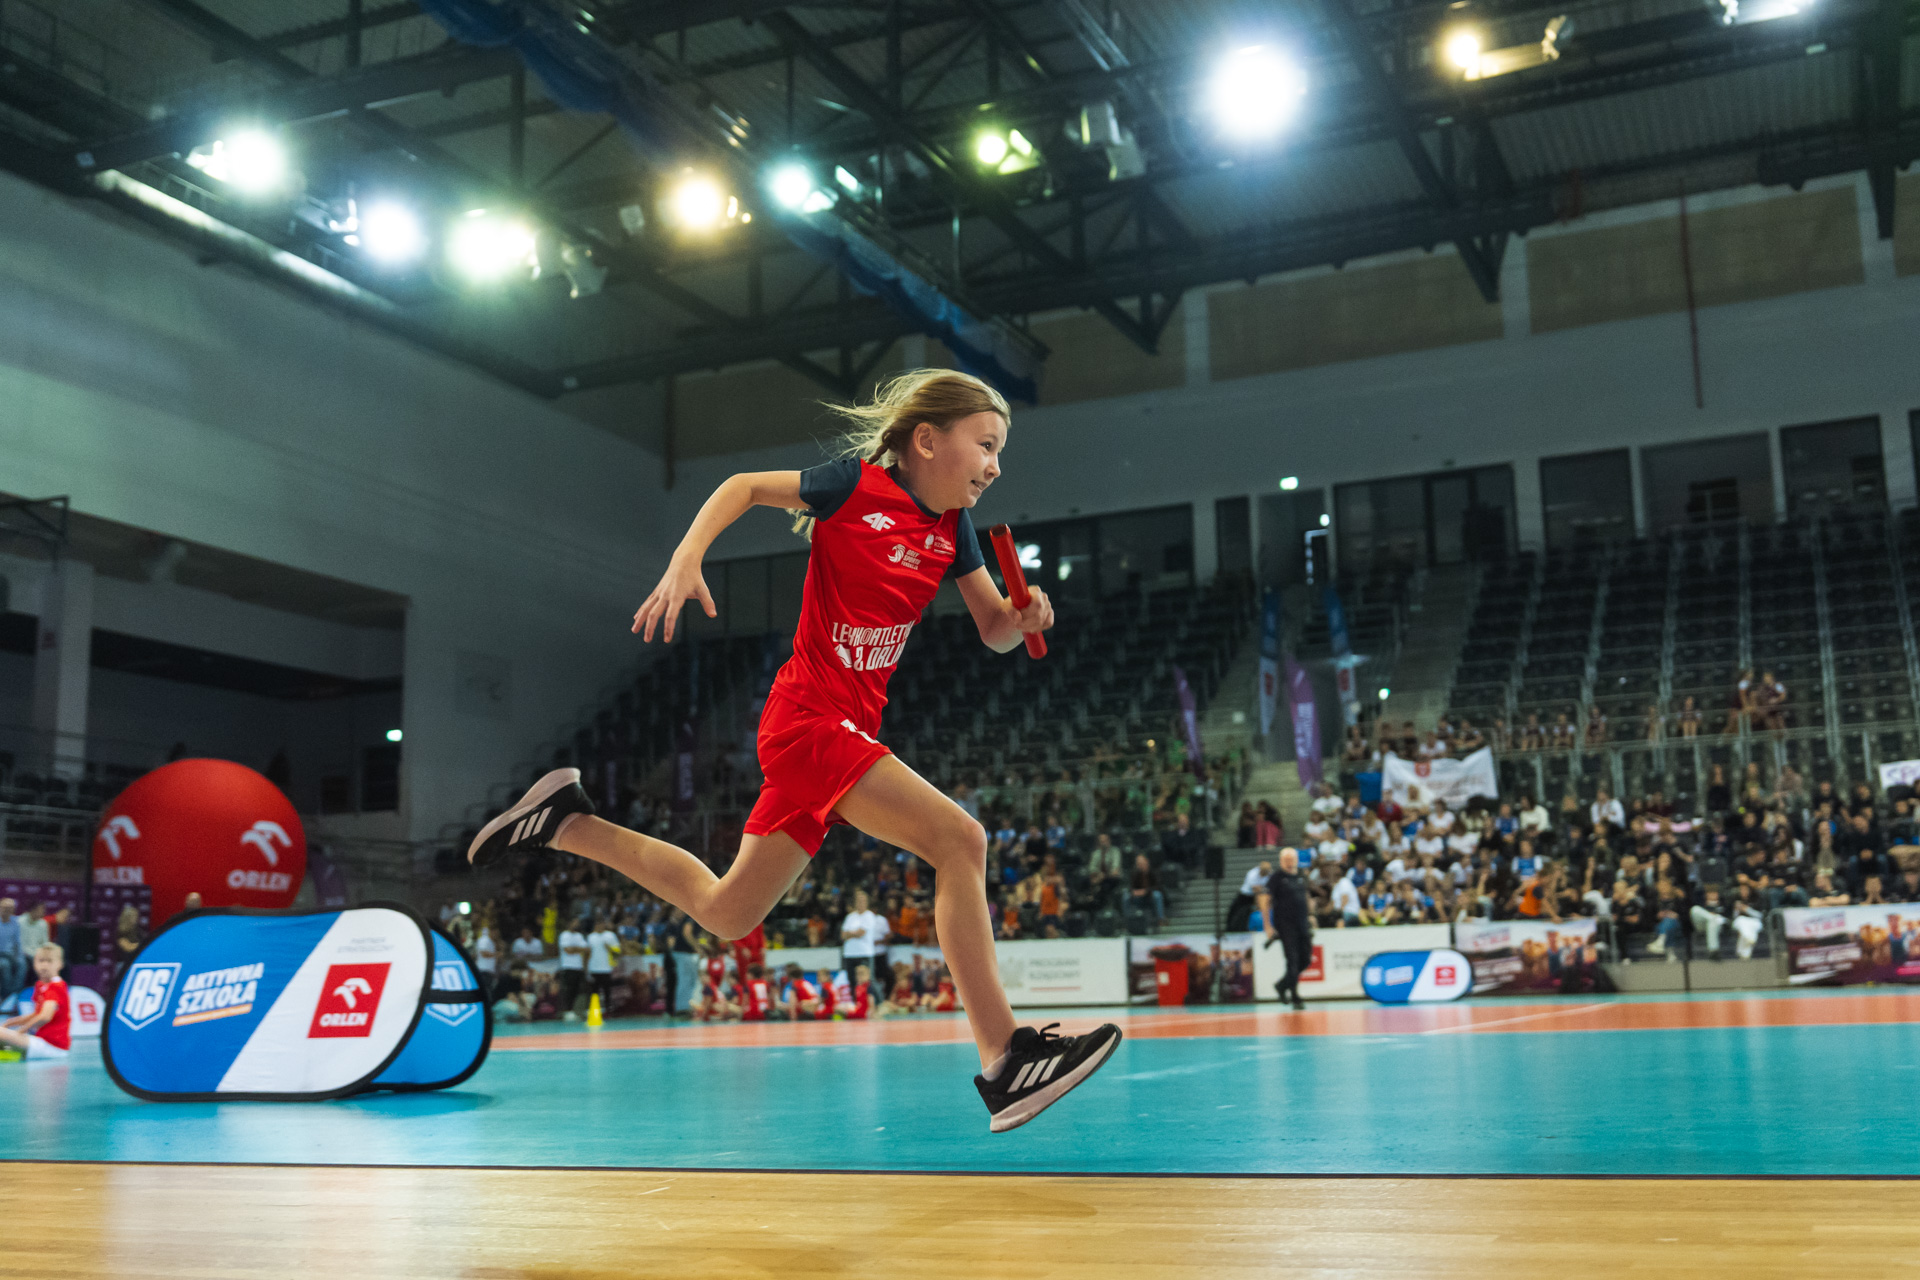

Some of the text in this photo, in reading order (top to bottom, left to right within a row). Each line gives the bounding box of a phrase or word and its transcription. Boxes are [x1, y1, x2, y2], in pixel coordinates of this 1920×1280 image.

[861, 512, 896, 531] 4F
[227, 869, 292, 892] ORLEN
[182, 962, 265, 993] AKTYWNA
[124, 968, 172, 1021] AS
[175, 980, 258, 1016] SZKOŁA
[319, 1012, 369, 1027] ORLEN
